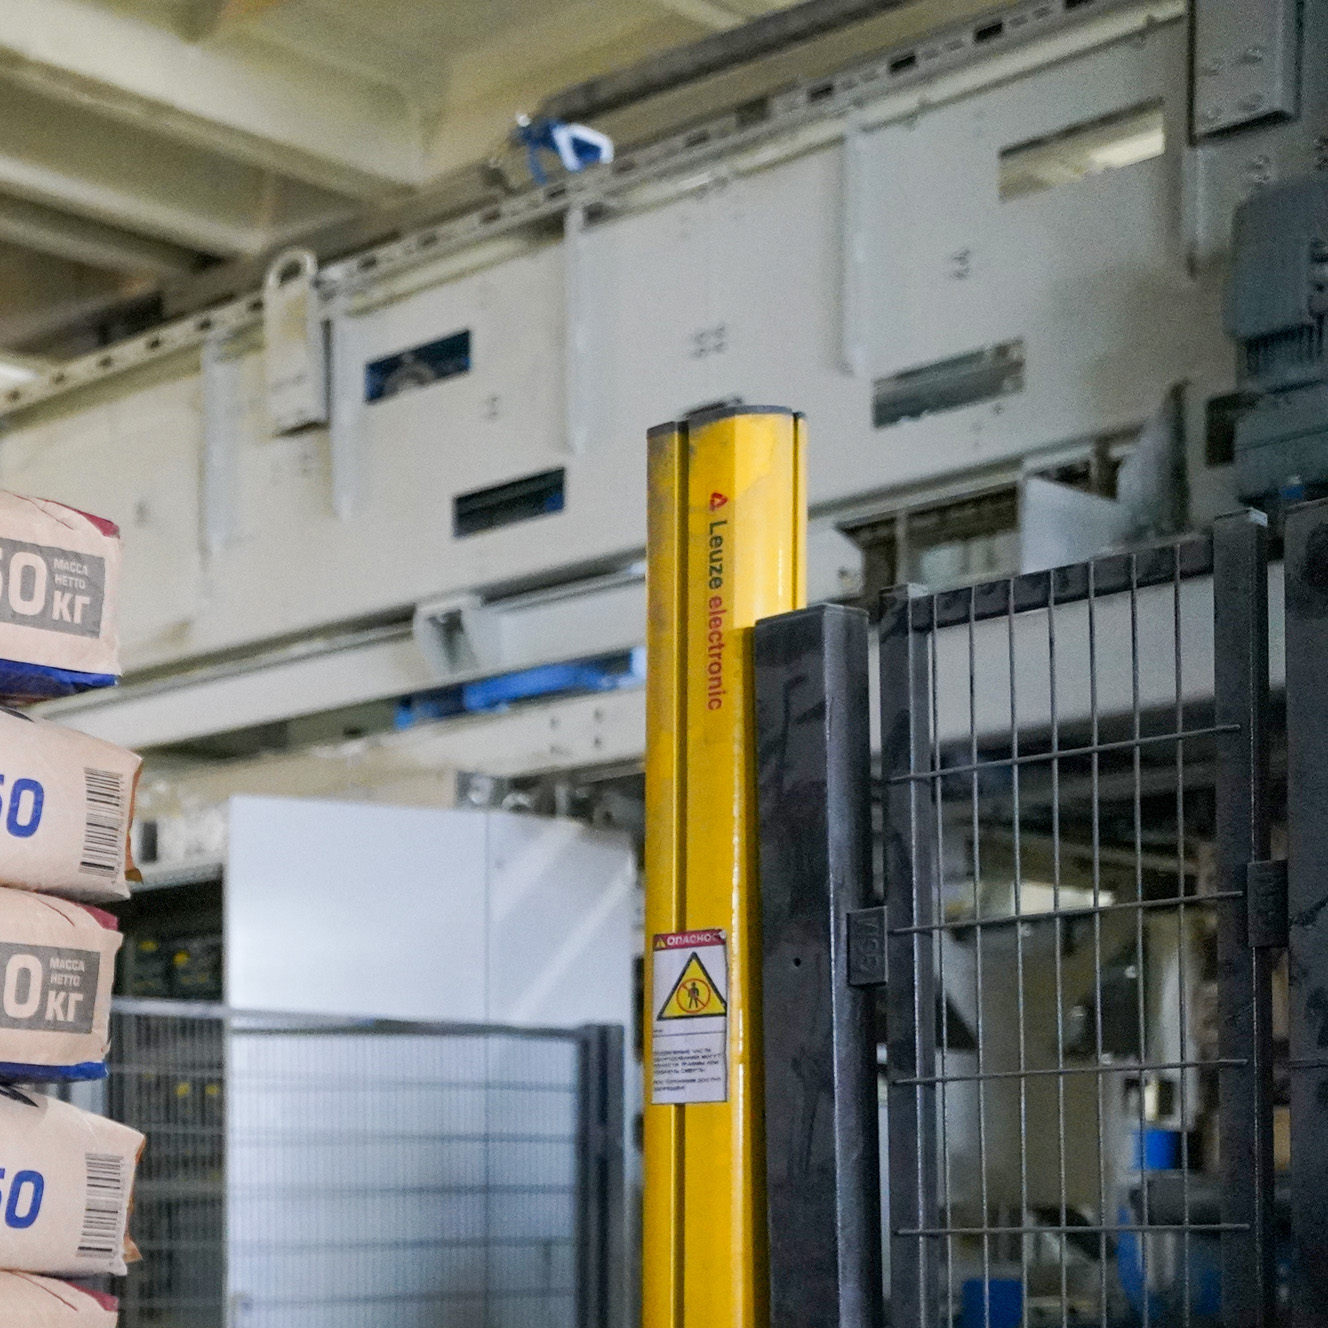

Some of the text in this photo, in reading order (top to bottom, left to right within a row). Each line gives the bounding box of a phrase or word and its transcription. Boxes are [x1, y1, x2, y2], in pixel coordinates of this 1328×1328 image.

[52, 591, 90, 623] КГ
[707, 519, 727, 711] Leuze electronic
[46, 991, 83, 1024] КГ
